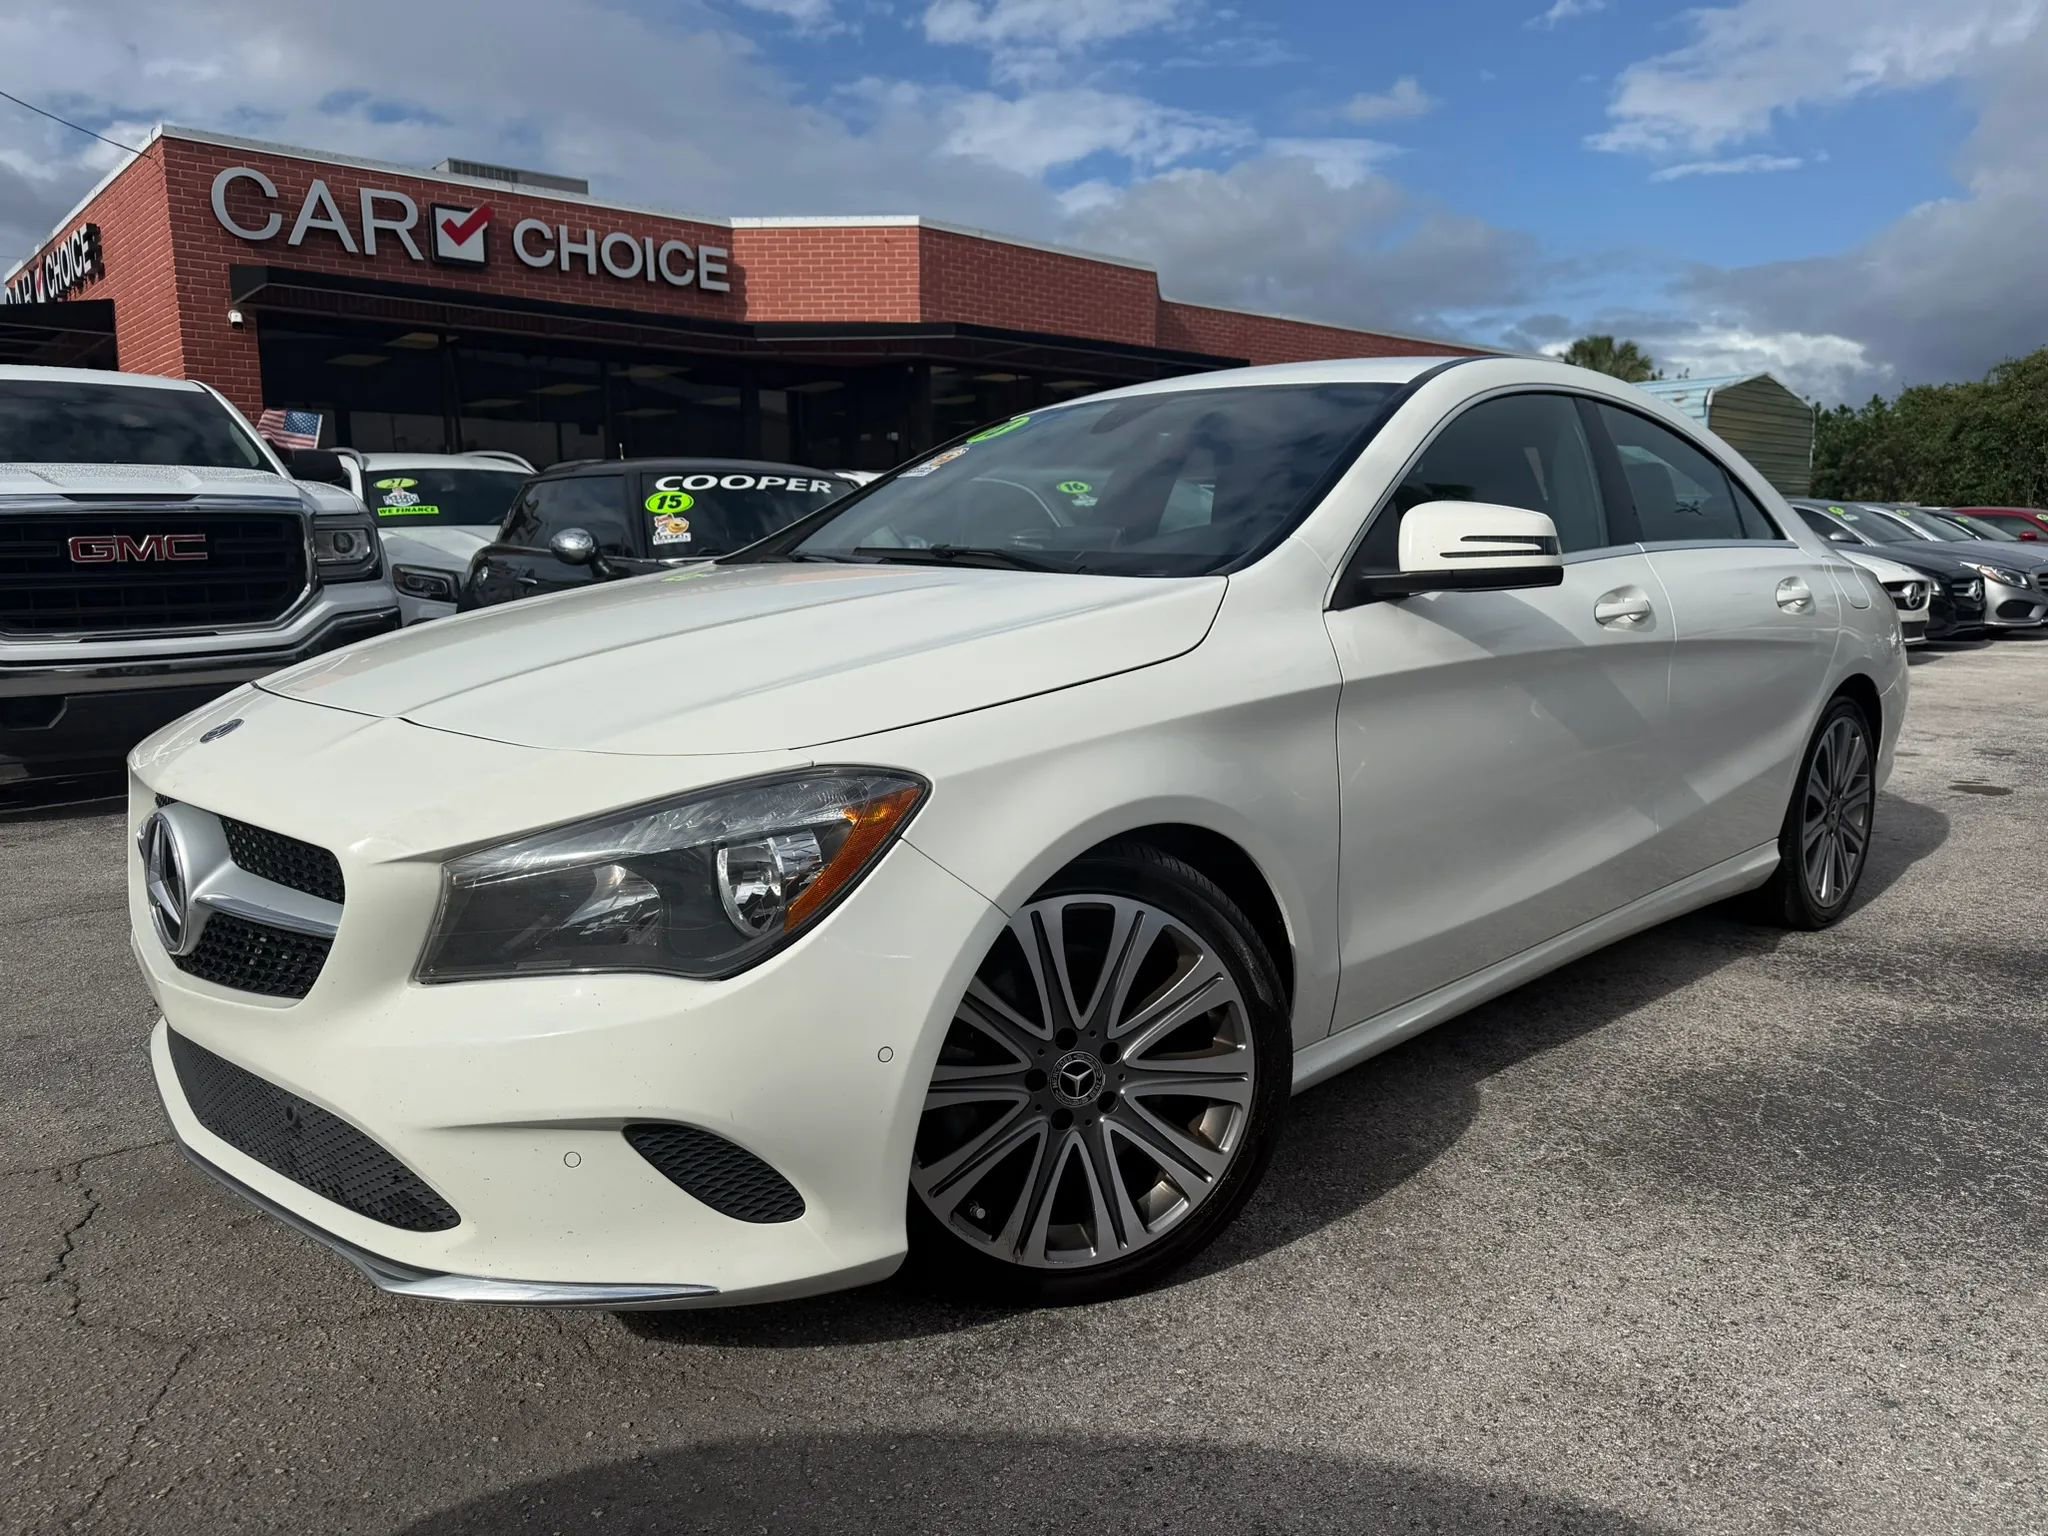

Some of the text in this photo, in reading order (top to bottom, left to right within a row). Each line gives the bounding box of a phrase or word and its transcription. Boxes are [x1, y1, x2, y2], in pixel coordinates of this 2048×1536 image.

[211, 166, 731, 292] CAR CHOICE
[45, 223, 92, 298] CHOICE
[655, 474, 832, 494] COOPER
[657, 495, 682, 510] 15
[69, 534, 208, 563] GMC
